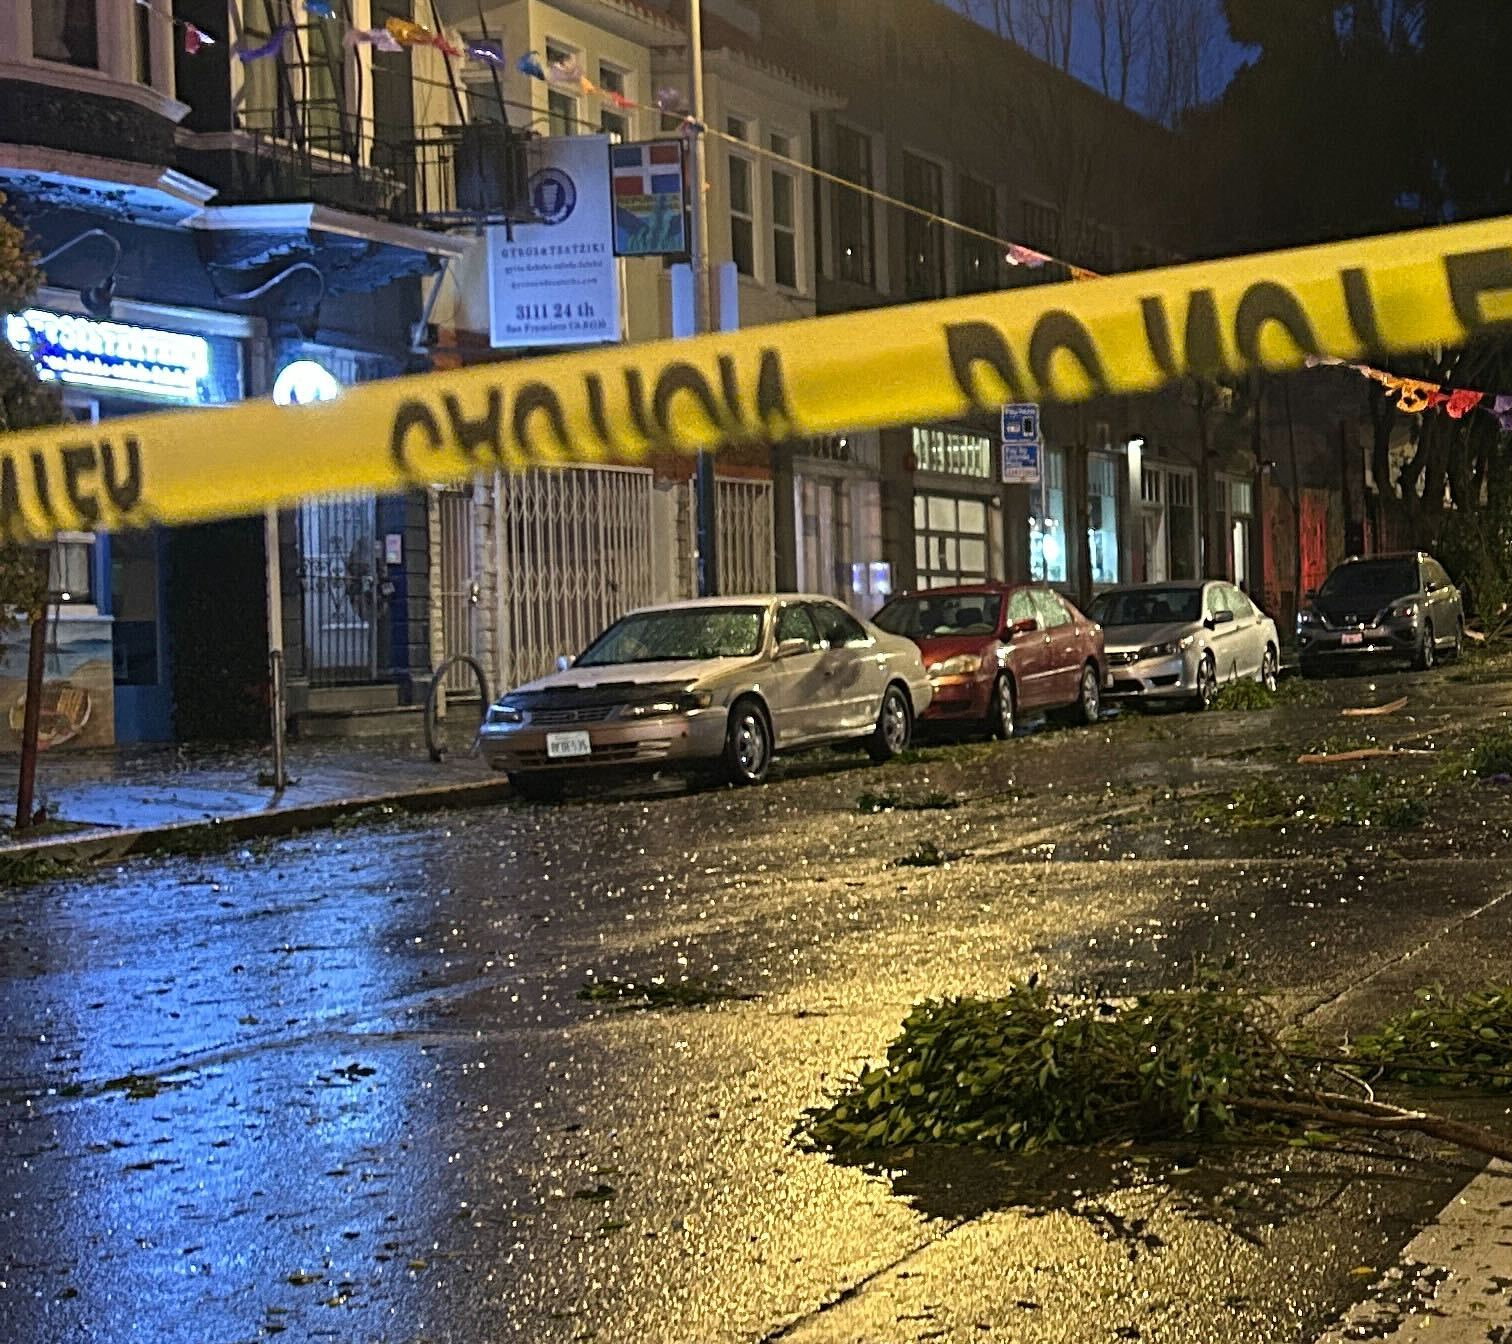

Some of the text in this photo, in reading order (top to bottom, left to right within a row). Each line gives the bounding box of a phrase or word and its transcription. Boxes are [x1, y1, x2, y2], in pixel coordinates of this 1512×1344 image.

[516, 302, 595, 320] 3111 24 th
